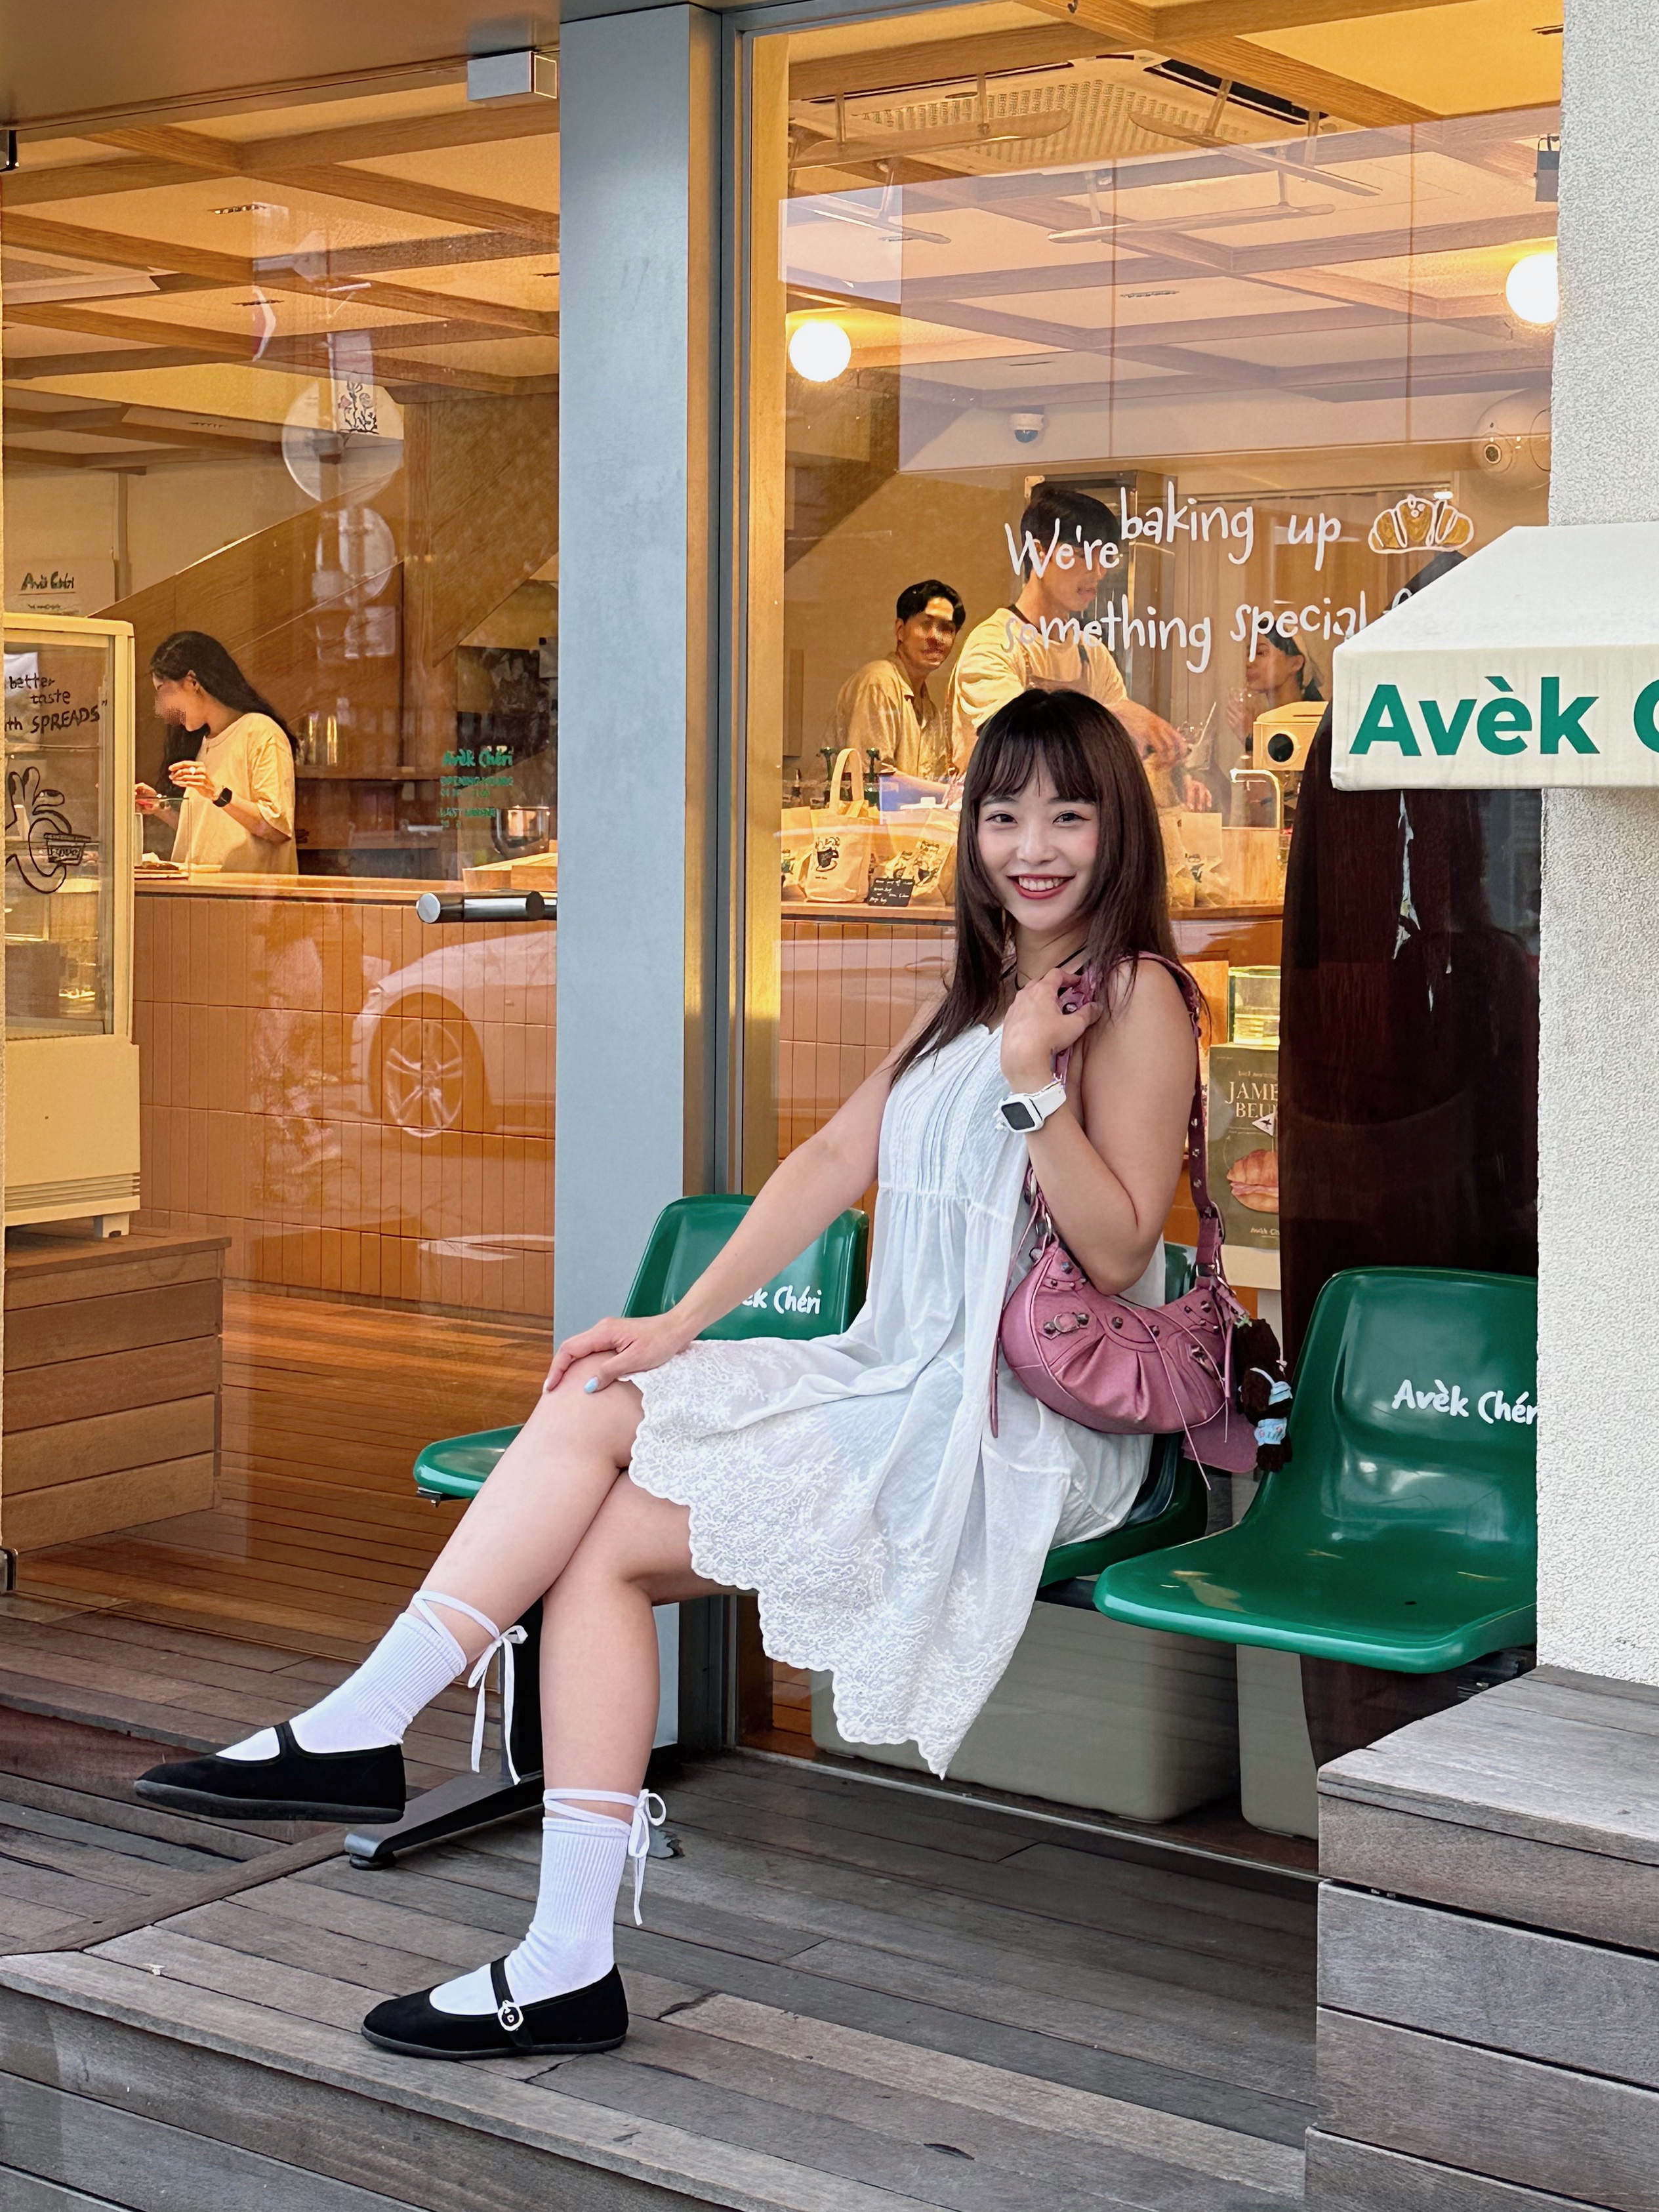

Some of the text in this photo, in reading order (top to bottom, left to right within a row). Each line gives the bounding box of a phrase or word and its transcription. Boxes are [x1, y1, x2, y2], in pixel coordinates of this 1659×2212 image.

[1004, 481, 1342, 579] We're baking up
[1000, 590, 1366, 674] something special
[9, 672, 55, 689] better
[30, 689, 71, 705] taste
[1349, 676, 1601, 756] Avèk
[773, 1284, 822, 1315] Chéri
[1391, 1379, 1538, 1425] Avèk Chér
